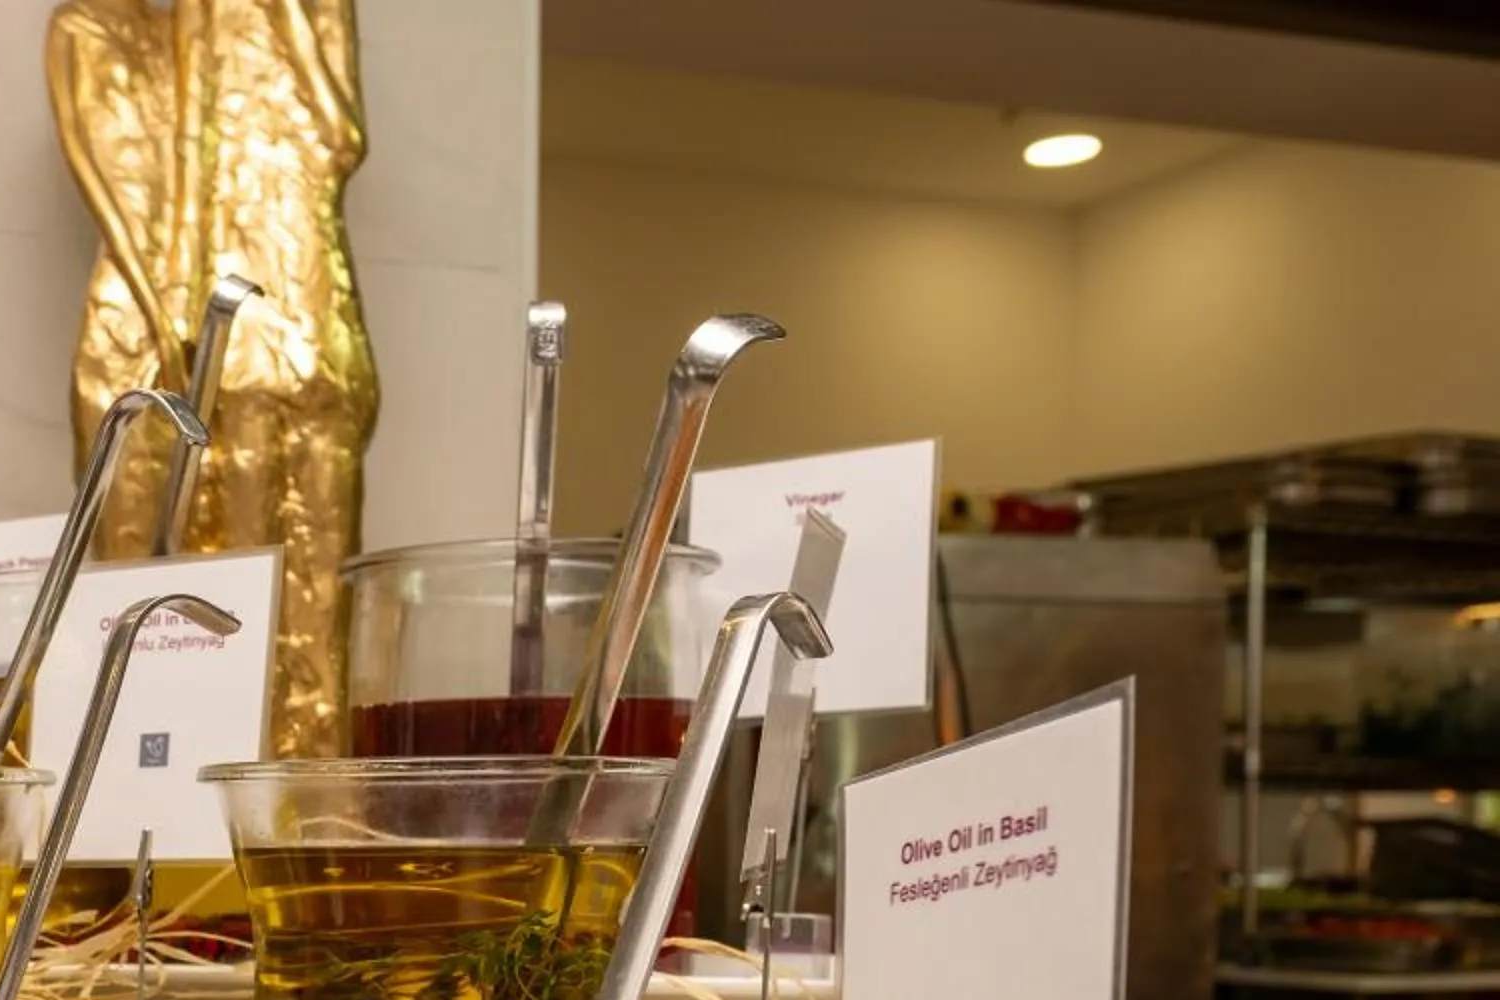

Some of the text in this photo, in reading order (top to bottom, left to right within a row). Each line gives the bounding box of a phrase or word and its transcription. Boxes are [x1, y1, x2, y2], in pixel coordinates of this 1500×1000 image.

[785, 491, 845, 508] Vinegar
[901, 806, 1048, 865] Olive Oil in Basil
[890, 845, 1058, 905] Fesleğenli Zeytinyağ
